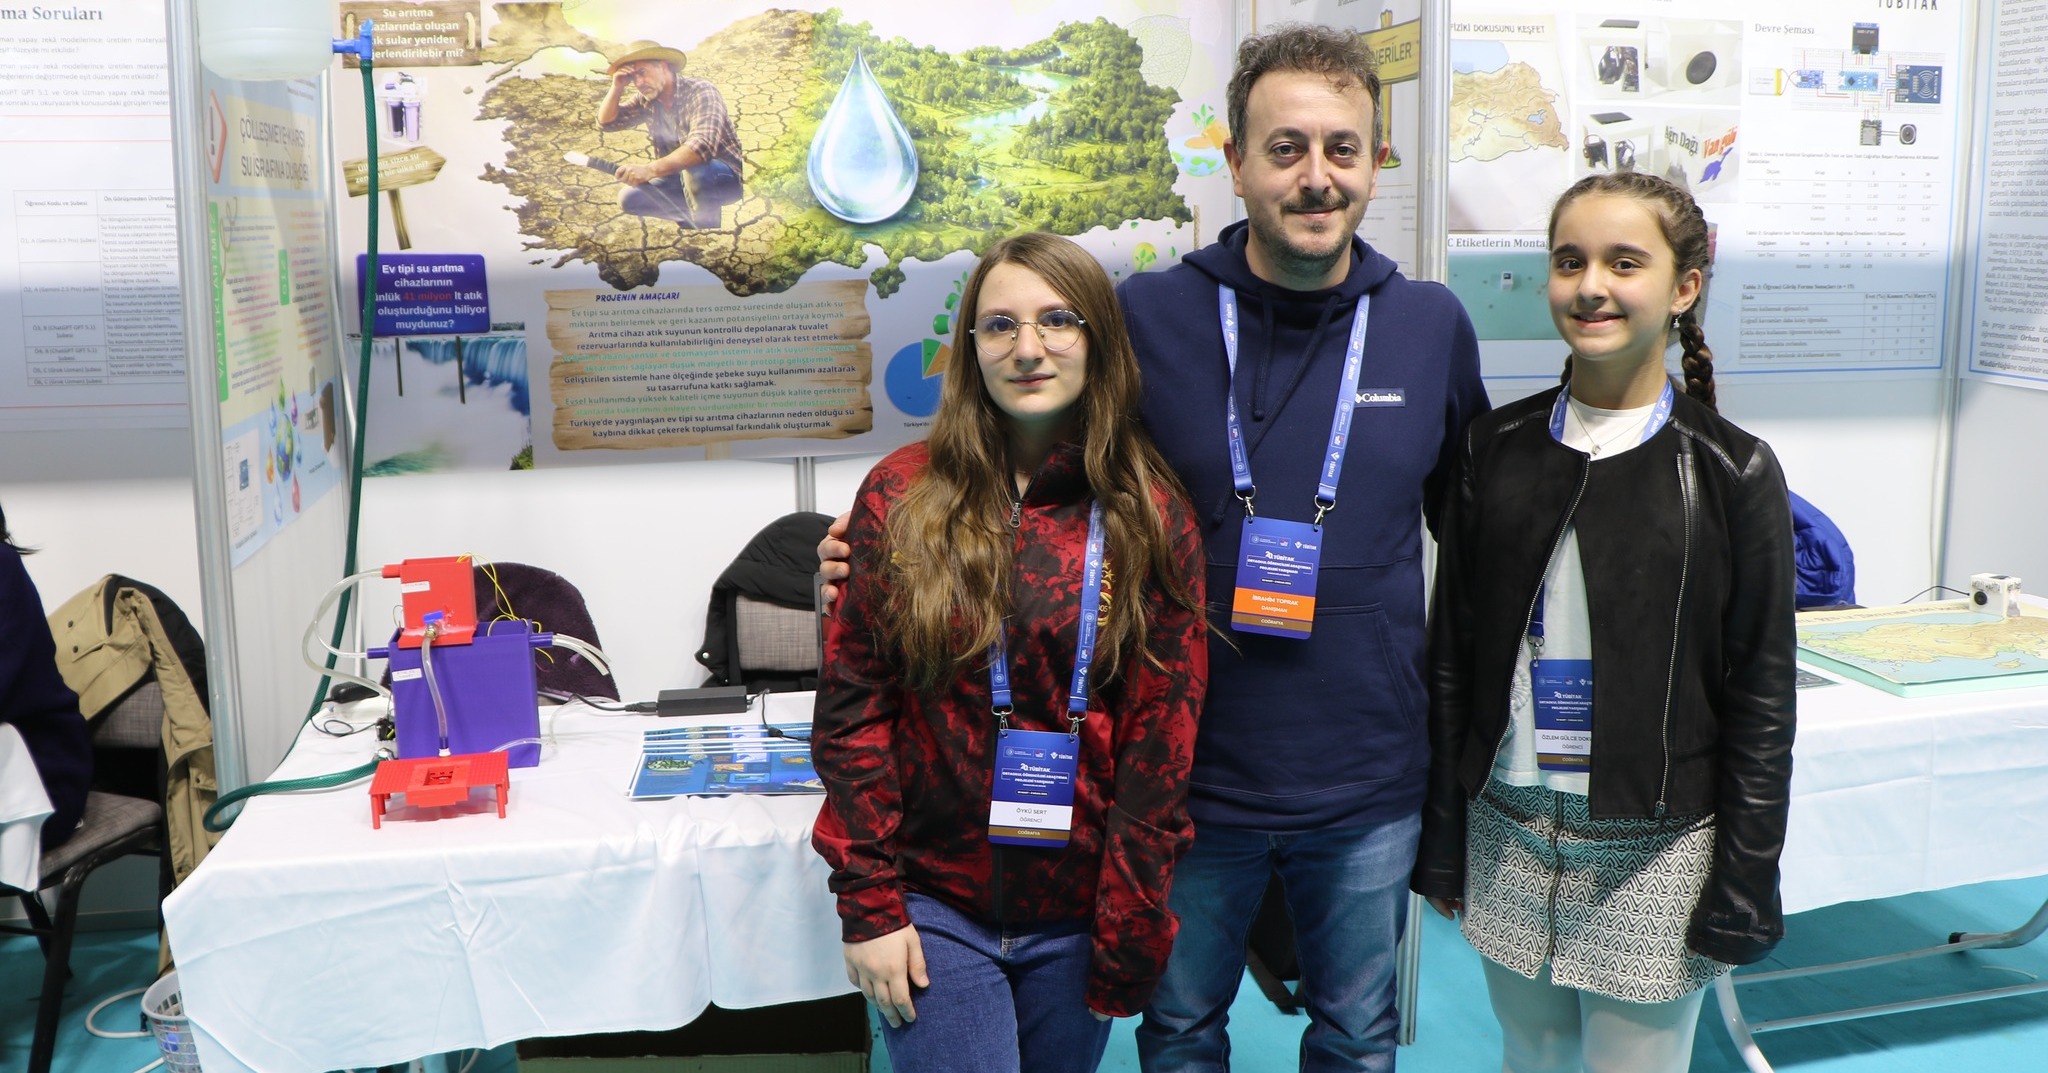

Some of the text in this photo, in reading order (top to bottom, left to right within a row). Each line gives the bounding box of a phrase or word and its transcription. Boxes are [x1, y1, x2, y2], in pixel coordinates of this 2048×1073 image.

[32, 6, 103, 21] Soruları
[383, 8, 434, 18] Su arıtma
[425, 22, 459, 33] oluşan
[1473, 24, 1515, 33] DOKUSUNU
[1517, 25, 1545, 35] KEŞFET
[1754, 23, 1815, 36] Devre Şeması
[386, 36, 412, 45] sular
[414, 36, 456, 47] yeniden
[445, 49, 464, 58] mi?
[1680, 131, 1699, 157] Dağı
[1703, 137, 1720, 159] Van
[1456, 238, 1511, 248] Etiketlerin
[382, 264, 465, 275] Ev tipi su arıtma
[394, 278, 453, 287] cihazlarının
[403, 292, 415, 301] 41
[418, 291, 452, 302] milyon
[463, 290, 483, 300] atık
[595, 292, 680, 303] PROJENİN AMAÇLARI
[377, 304, 487, 317] oluşturduğunu biliyor
[571, 309, 581, 317] Ev
[583, 308, 598, 318] tipi
[611, 308, 640, 316] arıtma
[641, 305, 694, 315] cihazlarında
[742, 303, 784, 311] sürecinde
[785, 302, 814, 310] oluşan
[395, 319, 455, 331] muydunuz?
[569, 320, 609, 328] miktarını
[610, 318, 656, 327] belirlemek
[669, 318, 687, 327] geri
[688, 316, 724, 325] kazanım
[726, 314, 780, 324] potansiyelini
[782, 313, 810, 322] ortaya
[811, 312, 844, 321] koymak
[588, 331, 618, 339] Arıtma
[619, 329, 645, 337] cihazı
[664, 329, 701, 338] suyunun
[703, 325, 742, 335] kontrollü
[744, 323, 797, 334] depolanarak
[798, 323, 829, 331] tuvalet
[576, 340, 648, 350] rezervuarlarında
[650, 335, 724, 348] kullanılabilirliğini
[726, 336, 763, 345] deneysel
[764, 335, 792, 343] olarak
[564, 374, 610, 385] Geliştirilen
[611, 373, 648, 382] sistemle
[672, 371, 713, 382] ölçeğinde
[715, 369, 745, 379] şebeke
[746, 369, 767, 377] suyu
[768, 367, 816, 376] kullanımını
[817, 365, 856, 373] azaltarak
[658, 382, 708, 392] tasarrufuna
[710, 381, 732, 389] katkı
[734, 380, 776, 390] sağlamak.
[565, 387, 857, 405] Evsel kullanımda yüksek kaliteli içme suyunun düşük kalite gerektiren
[1362, 393, 1402, 403] Columbia
[570, 418, 613, 428] Türkiye'de
[614, 416, 664, 427] yaygınlaşan
[678, 415, 693, 424] tipi
[706, 413, 735, 422] arıtma
[736, 411, 785, 420] cihazlarının
[786, 410, 813, 418] neden
[814, 409, 843, 418] olduğu
[592, 420, 833, 438] kaybına dikkat çekerek toplumsal farkındalık oluşturmak.
[1252, 594, 1299, 606] İBRAHİM TOPRAK
[1261, 605, 1288, 613] DANIŞMAN
[1260, 618, 1284, 626] COĞRAFYA
[1016, 807, 1033, 815] ÖYKÜ
